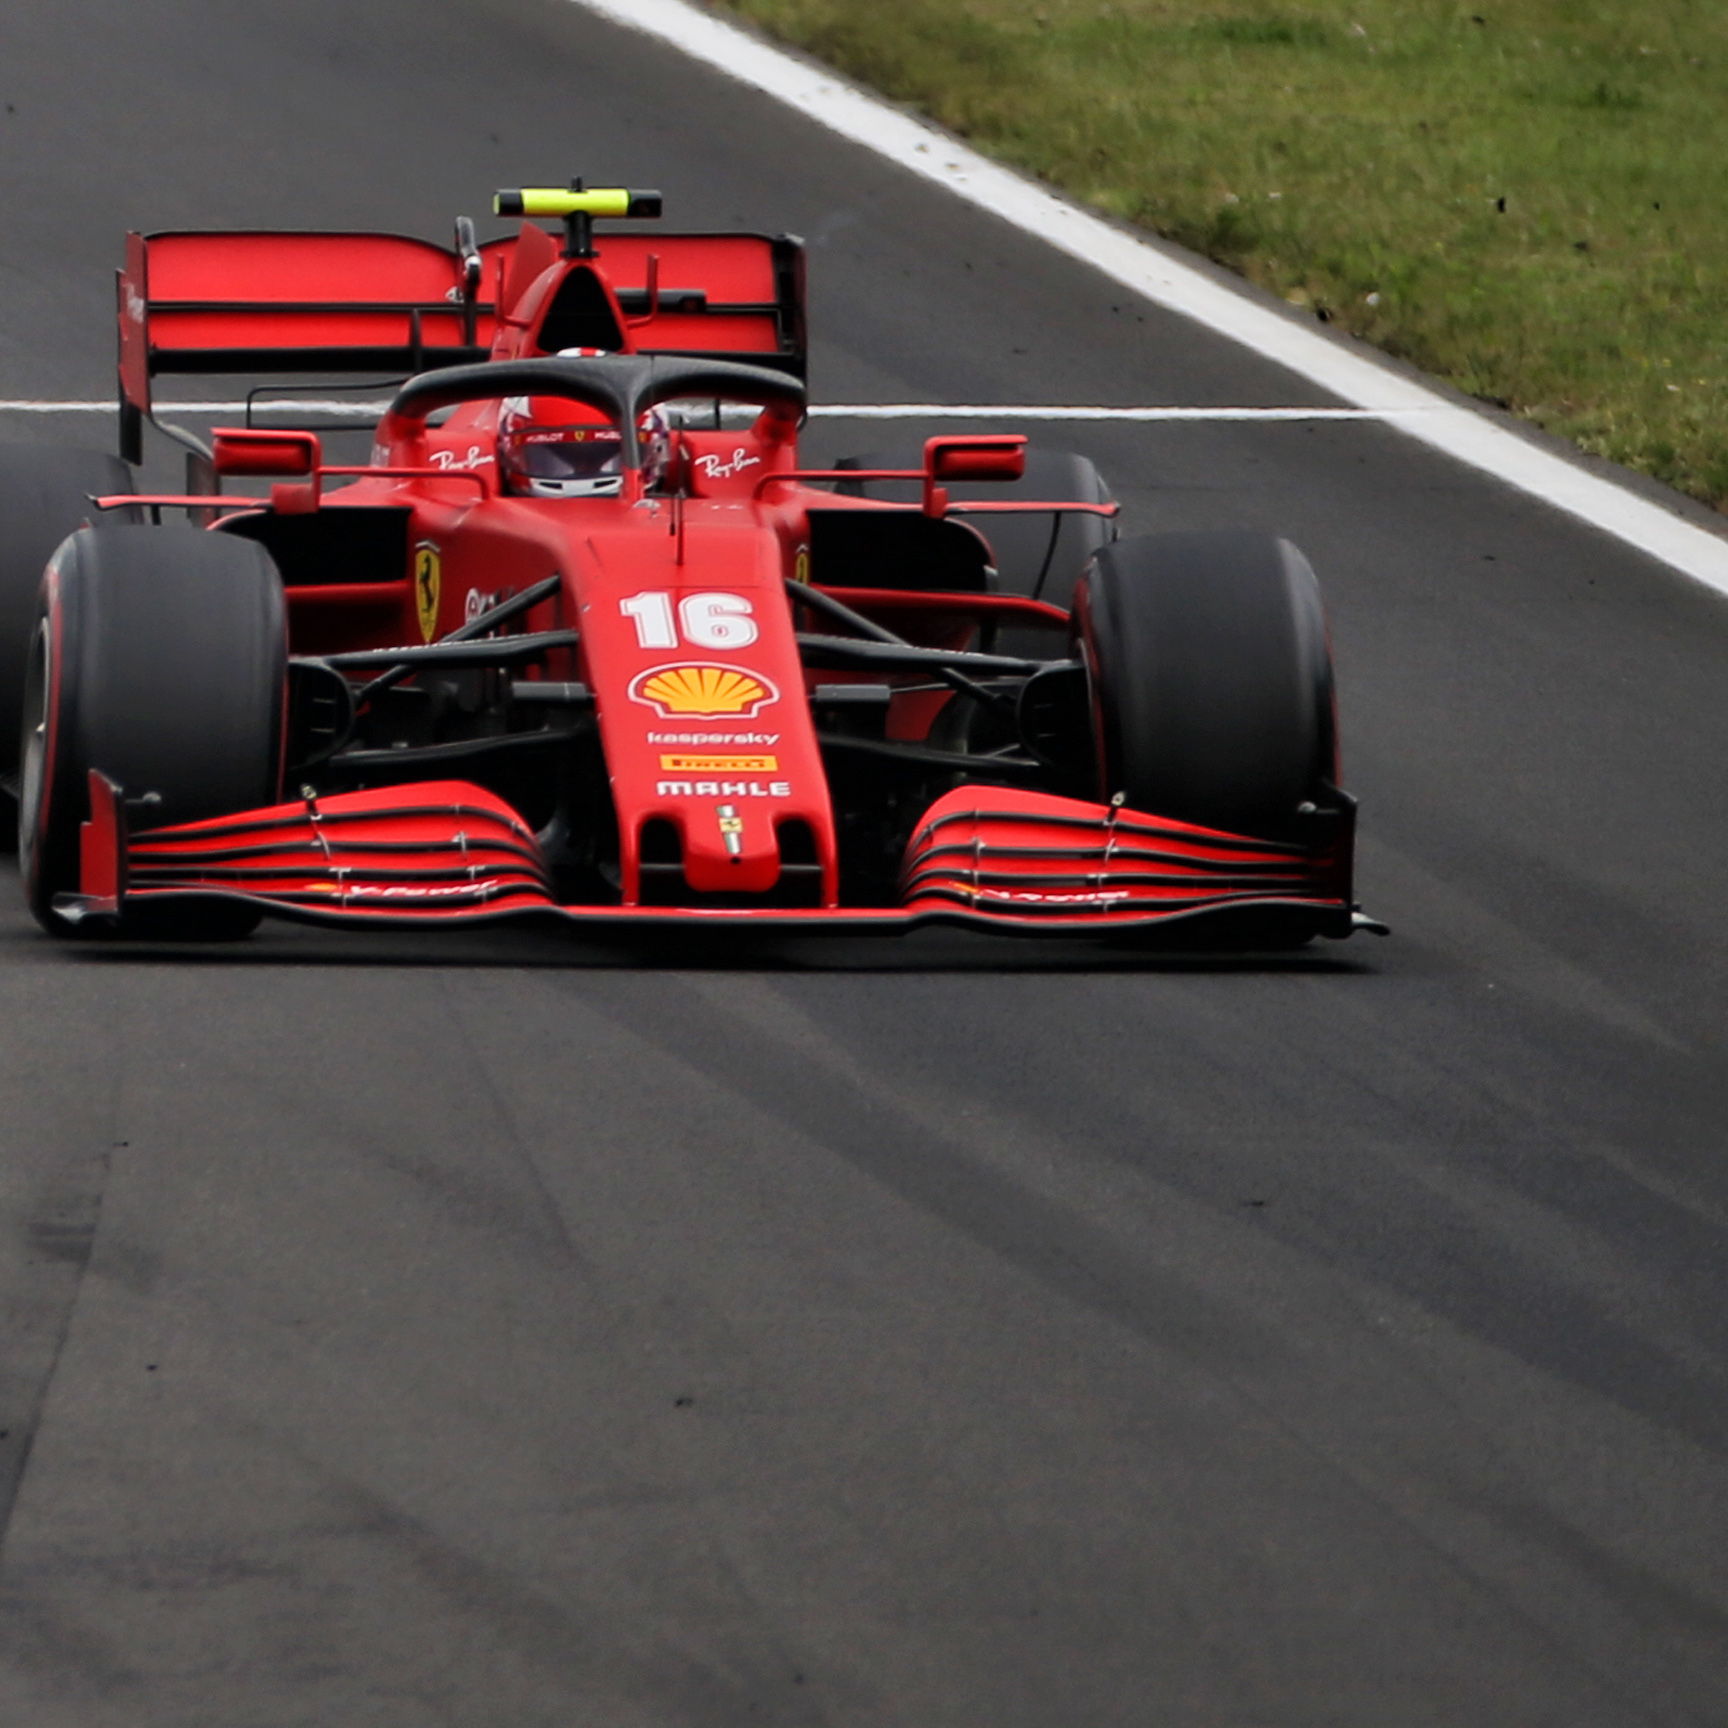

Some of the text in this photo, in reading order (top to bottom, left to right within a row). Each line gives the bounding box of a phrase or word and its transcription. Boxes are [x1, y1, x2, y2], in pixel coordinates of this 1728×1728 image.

[694, 448, 760, 478] Ray-Ban
[619, 591, 759, 650] 16
[647, 732, 780, 745] kaspersky
[656, 781, 791, 797] MAHLE
